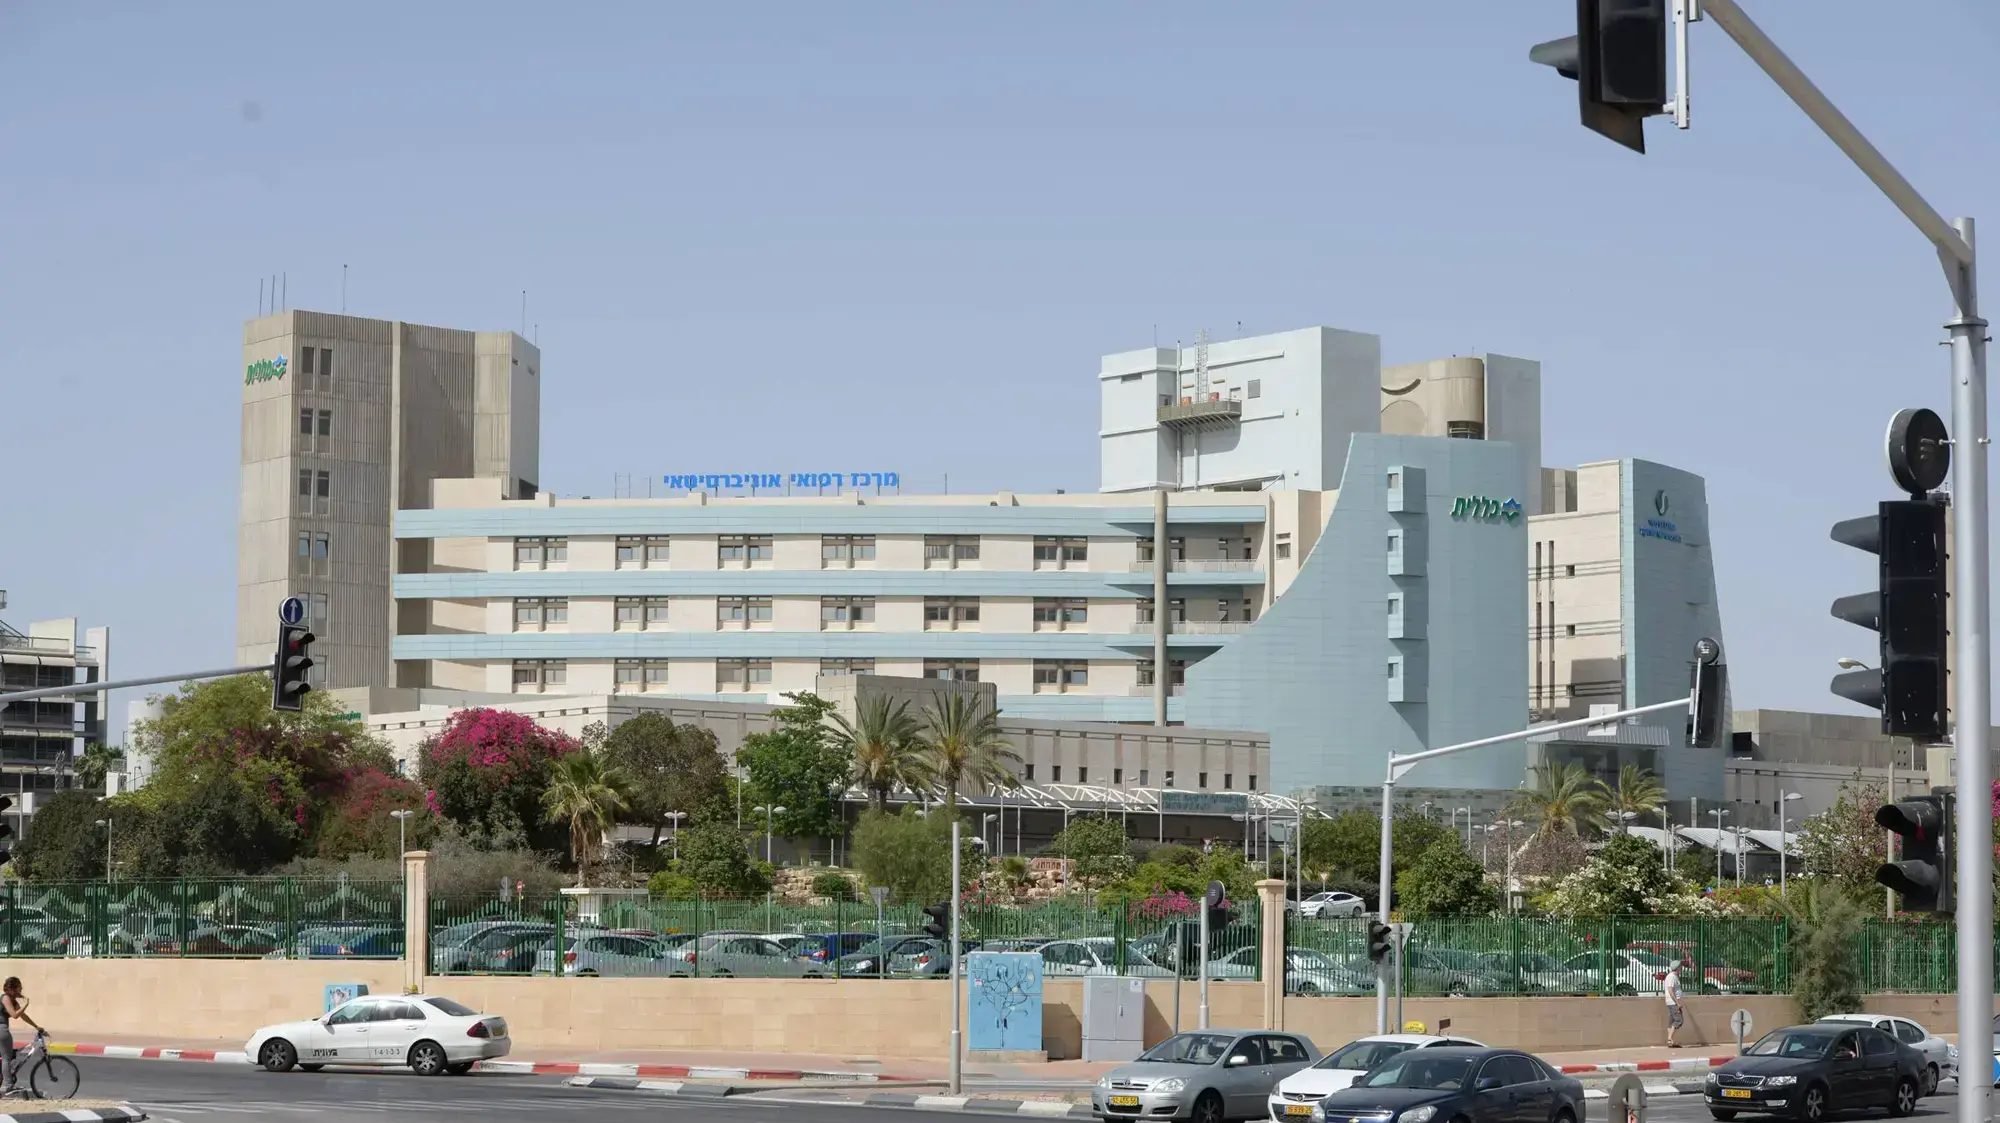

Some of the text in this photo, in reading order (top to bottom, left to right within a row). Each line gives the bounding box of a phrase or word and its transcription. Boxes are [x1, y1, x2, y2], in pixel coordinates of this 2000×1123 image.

[663, 472, 899, 489] מרכז רפואי אוניברסיטאי
[1450, 495, 1500, 517] כללית
[312, 1048, 338, 1057] מונית
